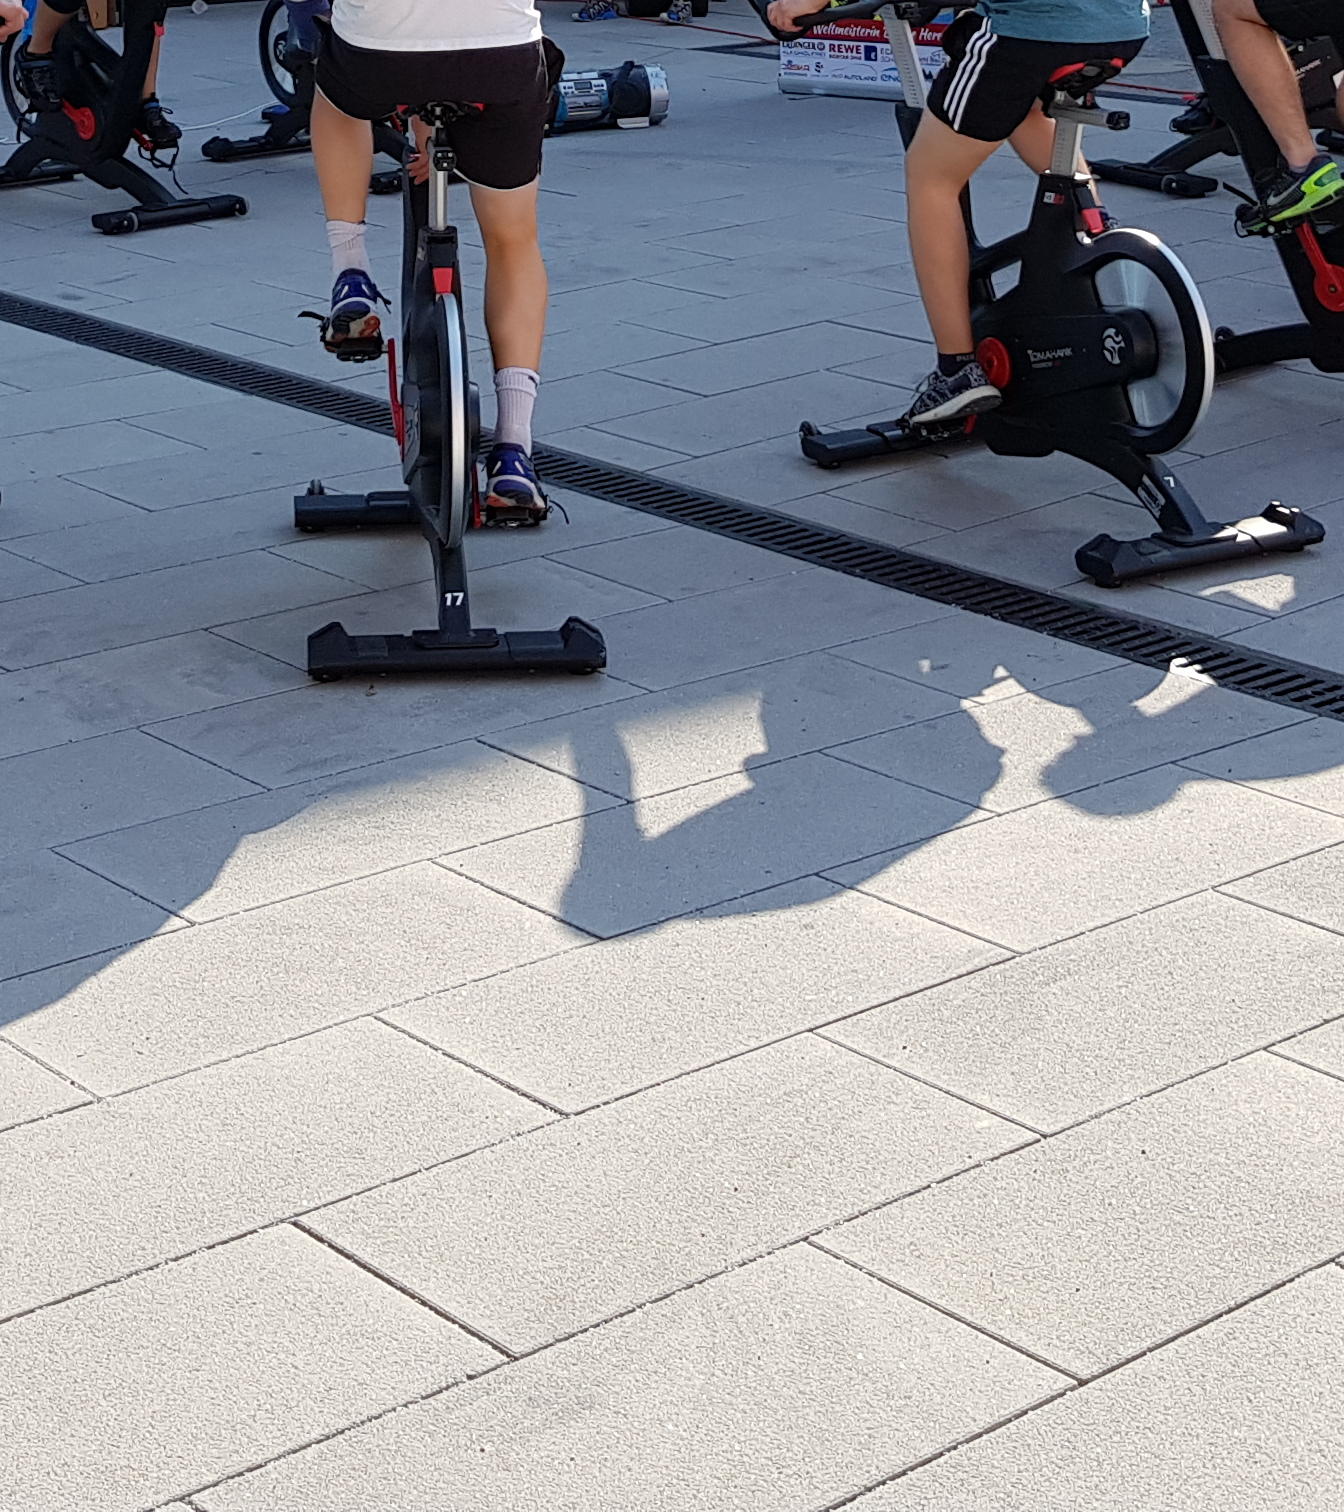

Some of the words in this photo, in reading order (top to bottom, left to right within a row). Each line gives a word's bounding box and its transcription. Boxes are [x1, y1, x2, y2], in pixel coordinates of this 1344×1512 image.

[813, 22, 881, 37] Weltmeisterin
[829, 43, 862, 54] REWE
[444, 592, 464, 606] 17
